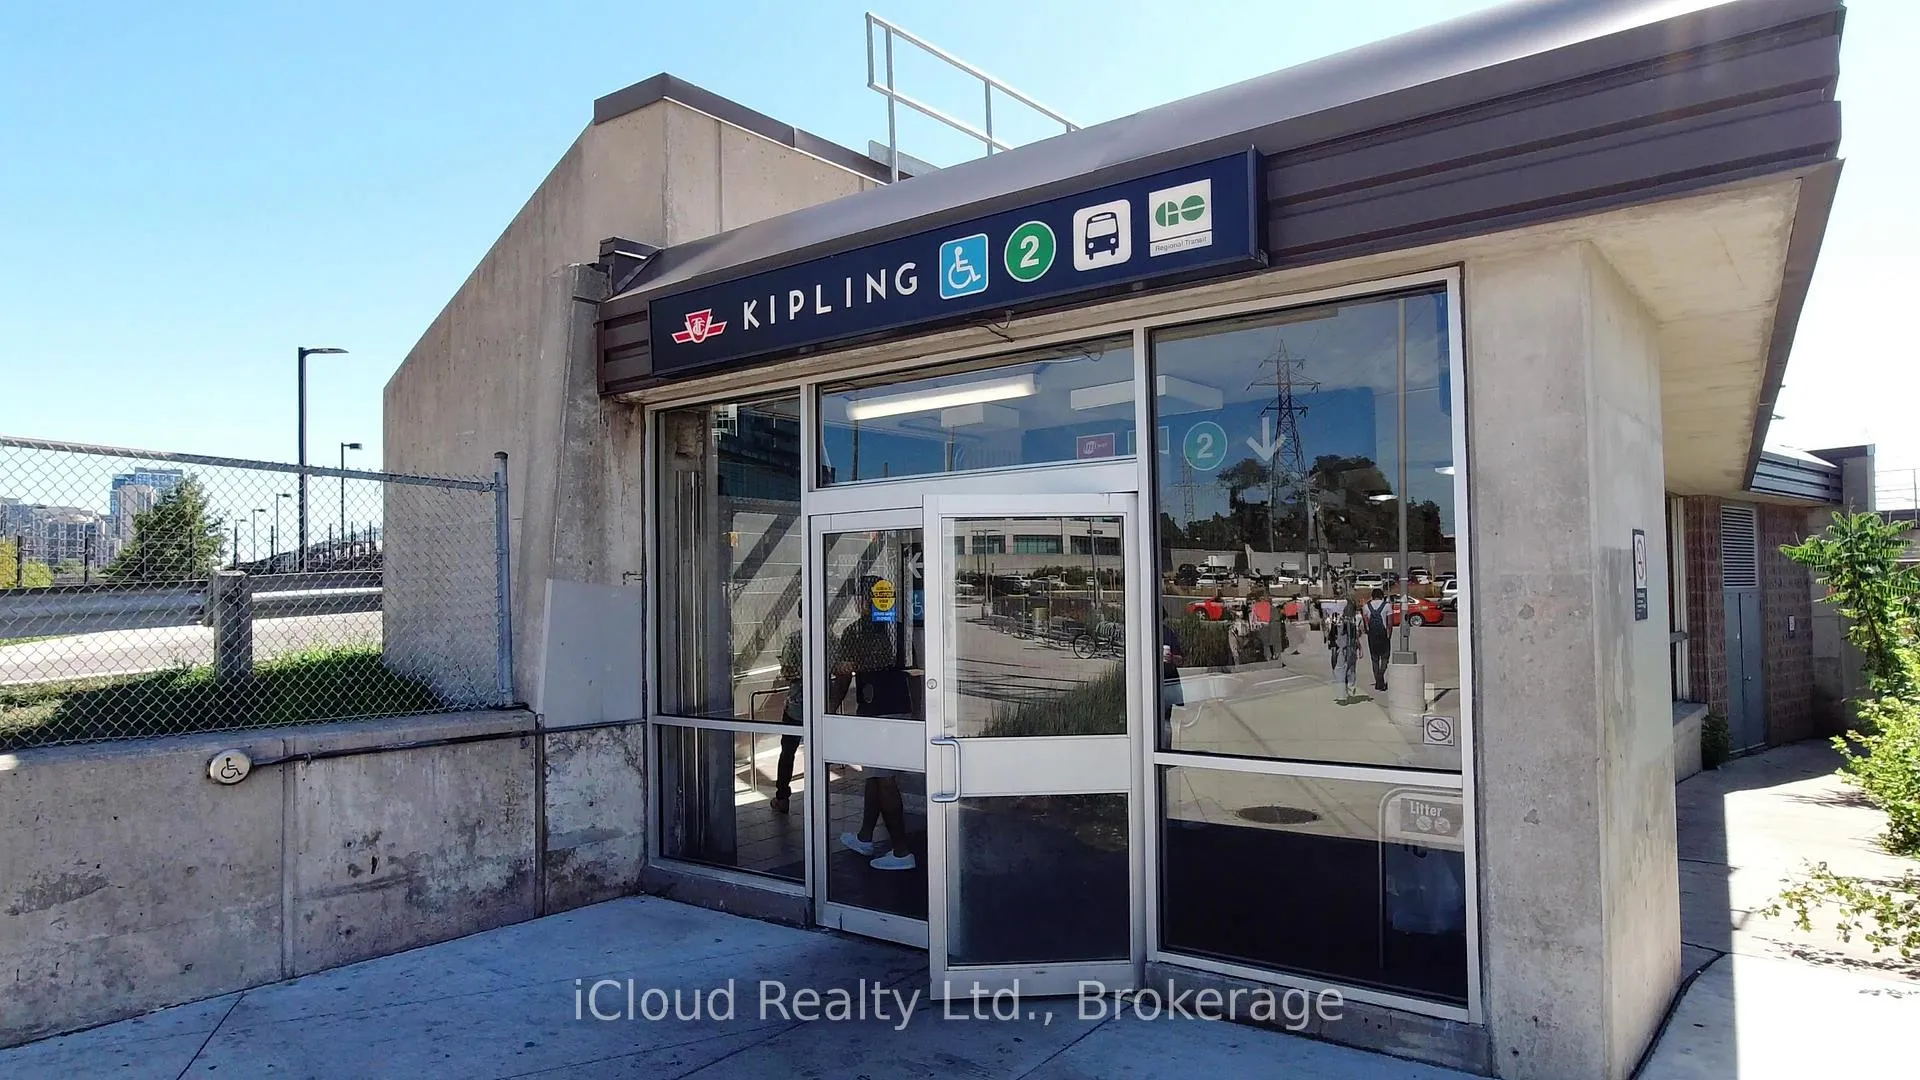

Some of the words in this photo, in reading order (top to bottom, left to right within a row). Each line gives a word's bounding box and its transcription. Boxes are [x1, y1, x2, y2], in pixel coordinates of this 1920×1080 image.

[1155, 240, 1184, 252] Regional
[1184, 236, 1207, 246] Transit
[743, 262, 918, 330] KIPLING
[1019, 235, 1041, 268] 2
[1196, 433, 1214, 459] 2
[1410, 801, 1442, 817] Litter
